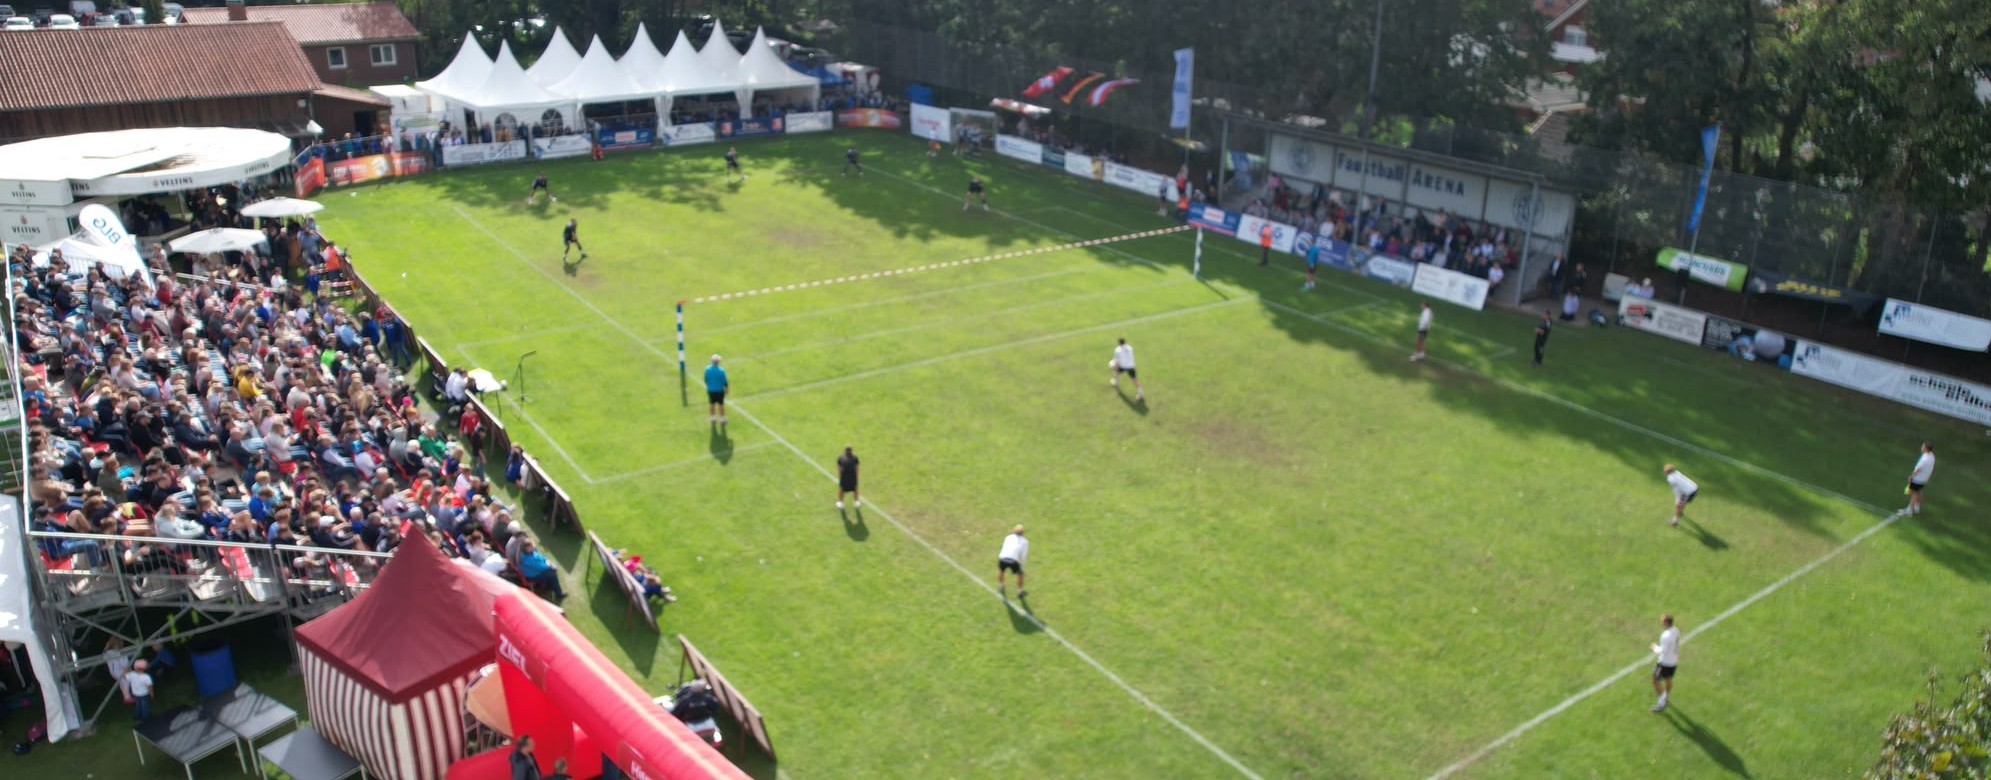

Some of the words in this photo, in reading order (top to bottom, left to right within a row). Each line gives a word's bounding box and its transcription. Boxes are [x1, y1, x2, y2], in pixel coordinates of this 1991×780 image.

[160, 176, 194, 187] VELTINS
[71, 182, 90, 191] TINS
[11, 190, 36, 198] VELTINS
[11, 225, 41, 234] VELTINS
[499, 634, 531, 681] ZIEL
